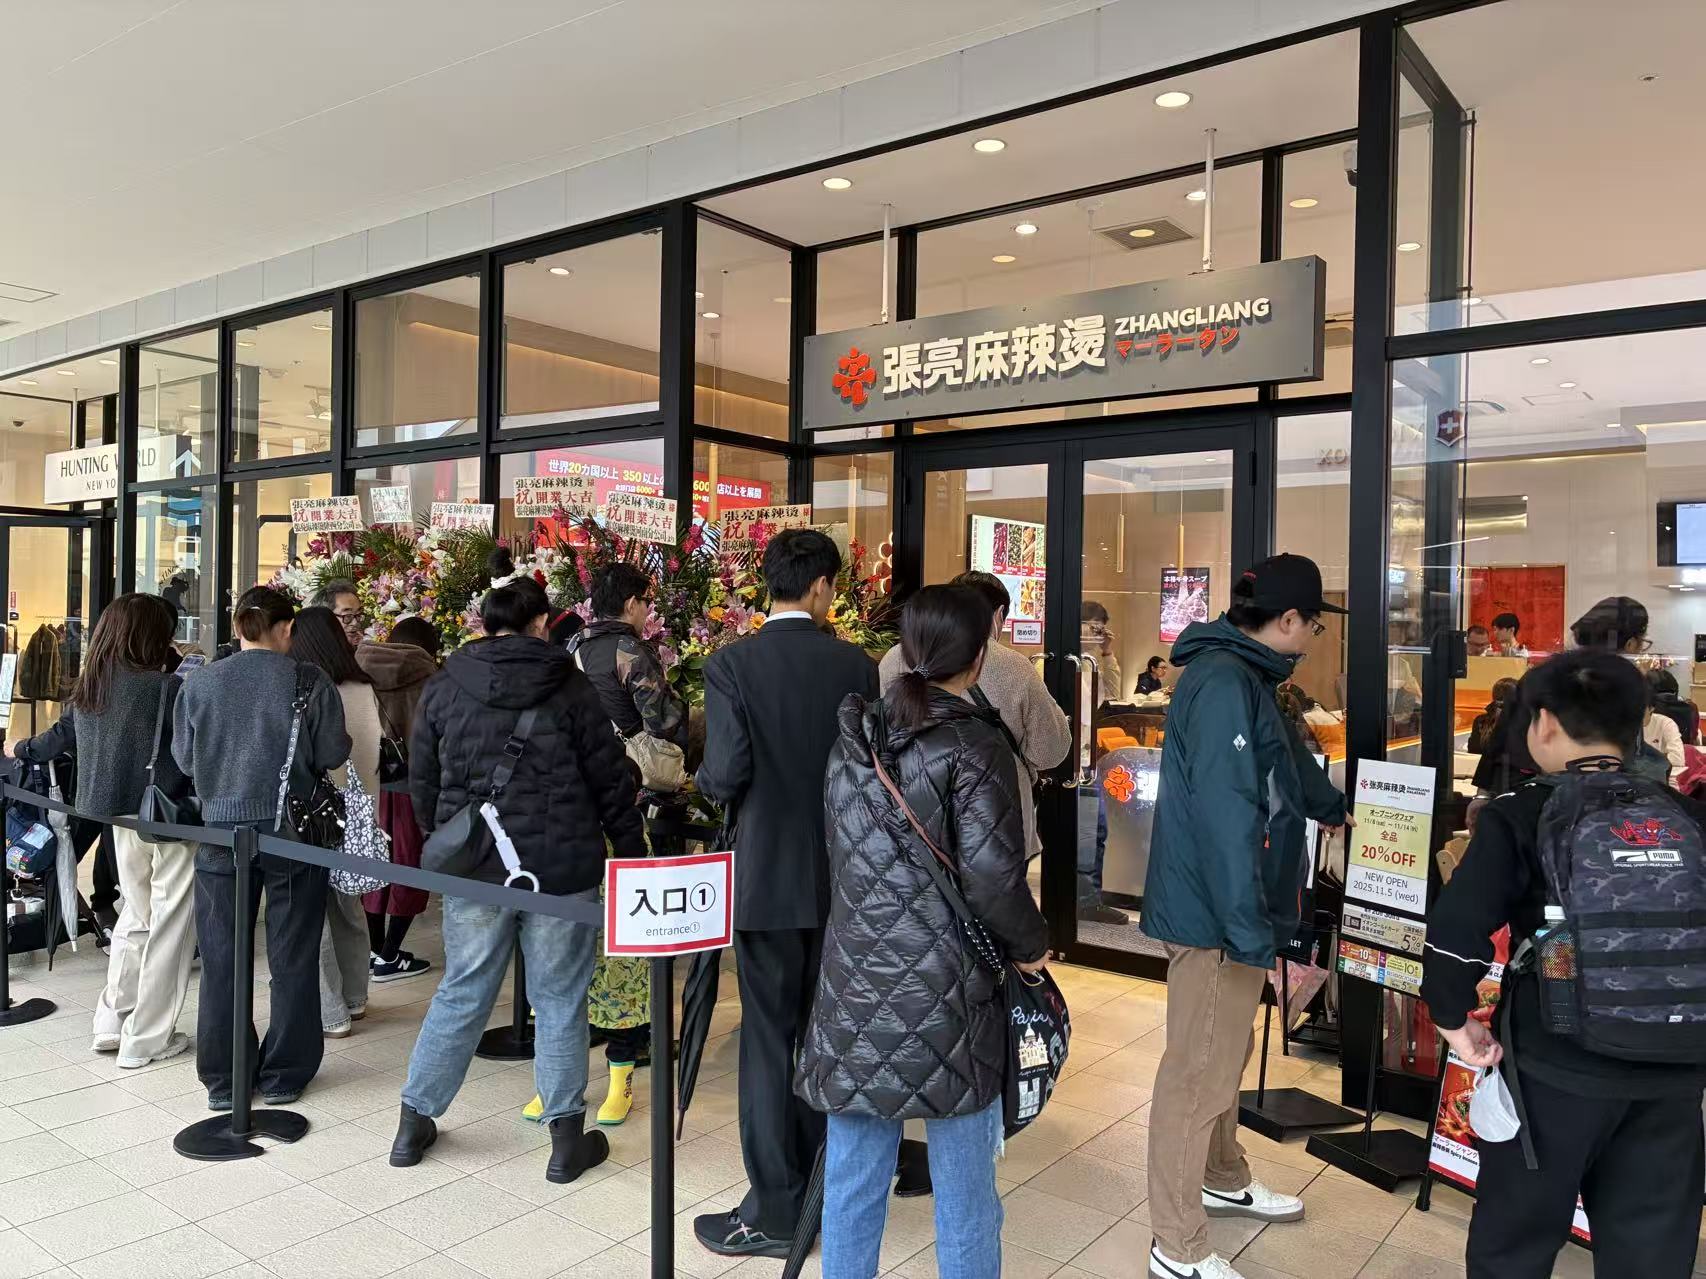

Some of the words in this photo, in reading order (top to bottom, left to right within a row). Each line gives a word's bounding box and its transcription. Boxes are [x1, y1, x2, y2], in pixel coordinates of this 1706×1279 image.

[1115, 298, 1270, 336] ZHANGLIANG
[882, 314, 1107, 394] 張亮麻辣燙
[1115, 326, 1239, 360] マーラータン
[61, 454, 109, 478] HUNTING
[86, 480, 102, 490] NEW
[1370, 809, 1415, 822] オープニングフェア
[1381, 830, 1398, 843] 全品
[1361, 844, 1417, 867] 20%OFF
[1652, 852, 1675, 860] PUMA
[1365, 871, 1384, 883] NEW
[1385, 876, 1408, 888] OPEN
[629, 882, 716, 917] 入口①
[1353, 880, 1393, 897] 2025.11.5
[1395, 890, 1419, 904] (wed)
[645, 921, 701, 937] entrance①
